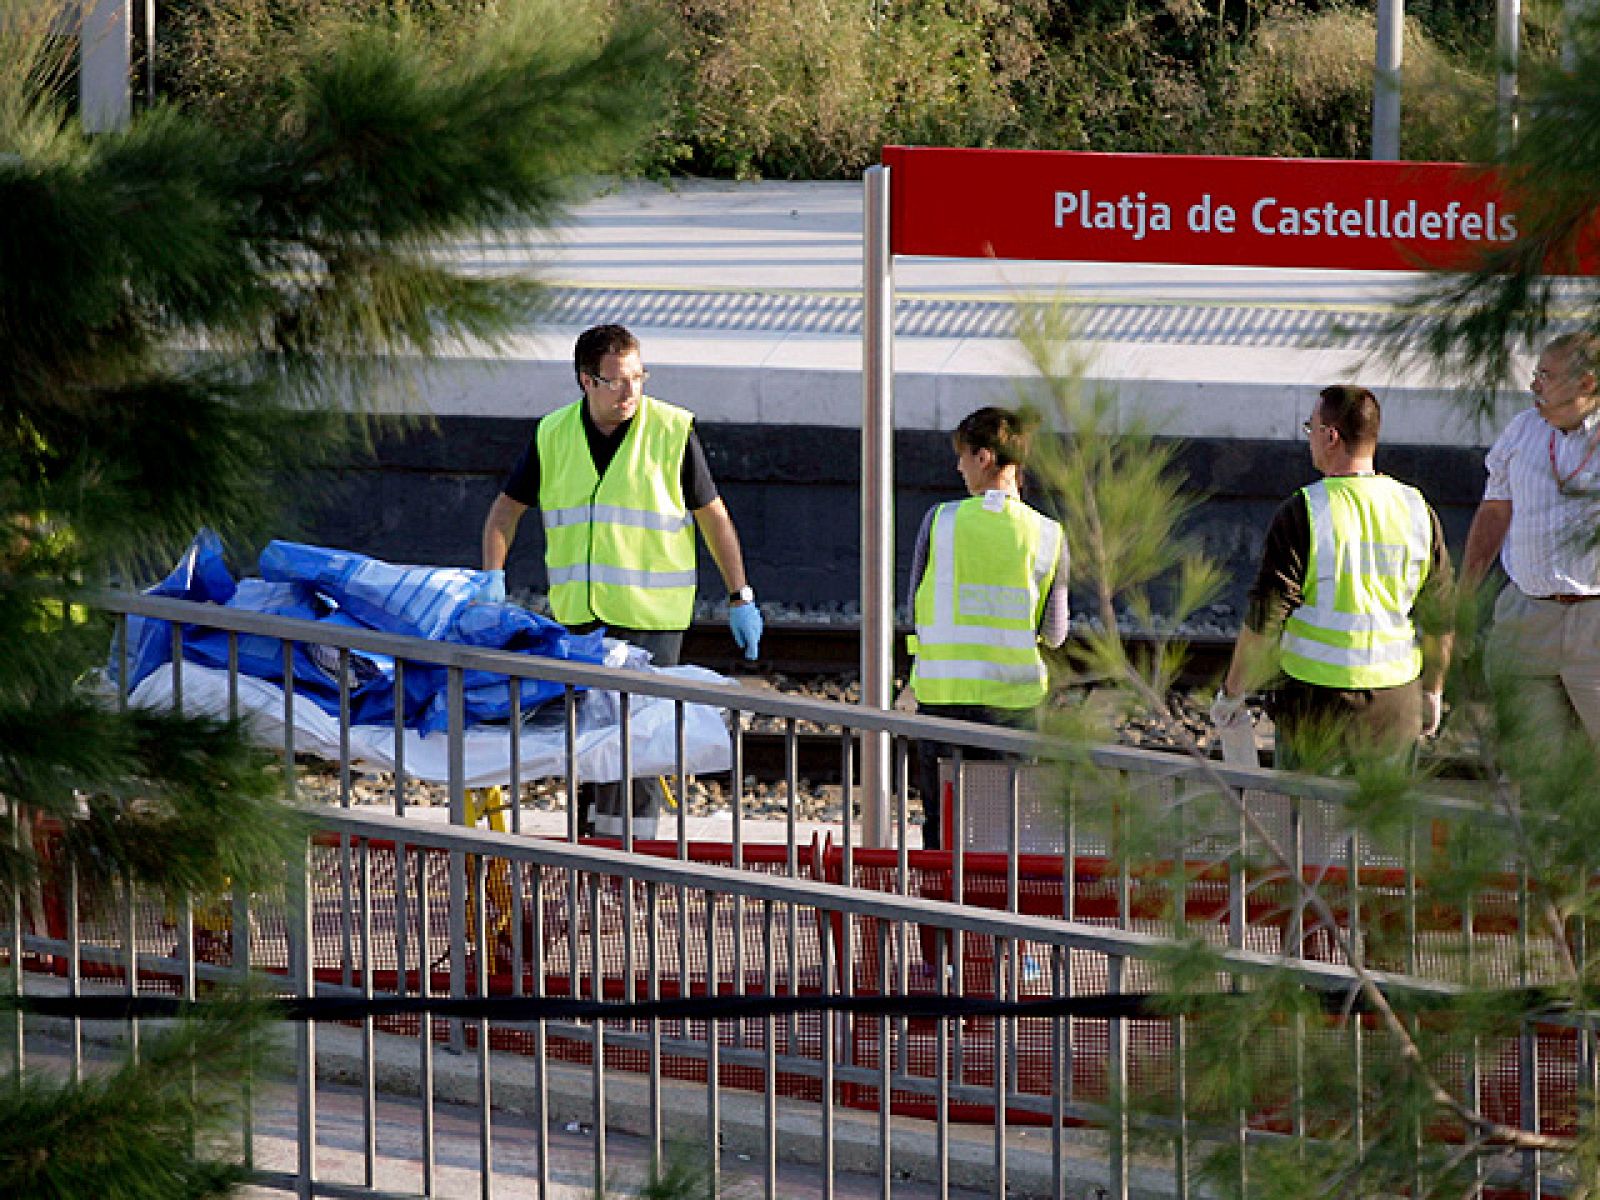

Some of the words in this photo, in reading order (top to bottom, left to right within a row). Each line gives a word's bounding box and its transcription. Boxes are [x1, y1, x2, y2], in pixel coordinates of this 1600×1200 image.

[1054, 190, 1171, 240] Platja
[1187, 194, 1236, 233] de
[1251, 197, 1518, 241] Castelldefels
